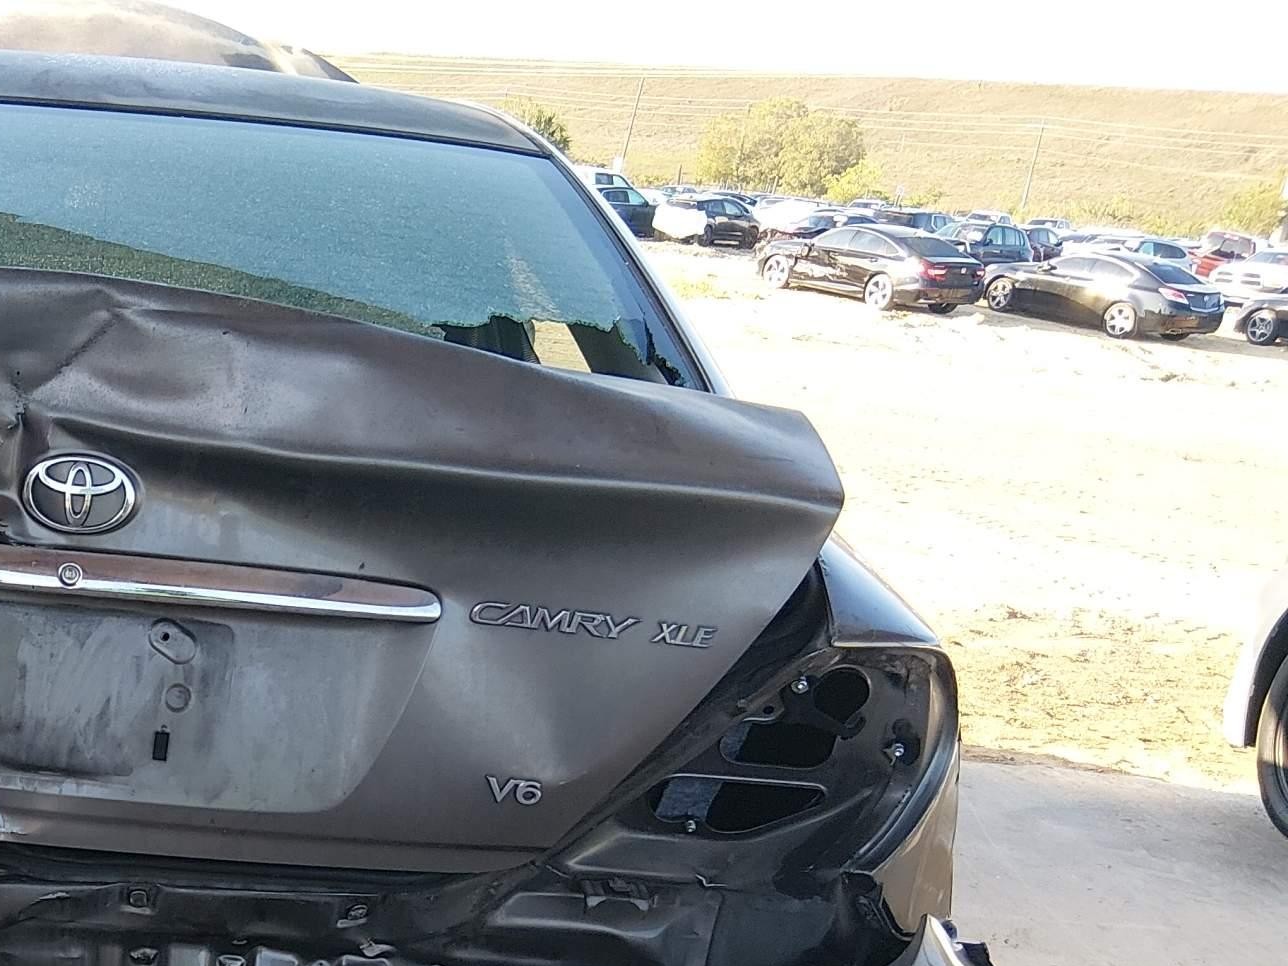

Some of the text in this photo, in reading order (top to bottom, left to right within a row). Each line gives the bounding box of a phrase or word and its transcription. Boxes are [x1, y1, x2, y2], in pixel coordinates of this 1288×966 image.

[469, 601, 718, 648] CAMRY XLE
[485, 775, 543, 807] V6
